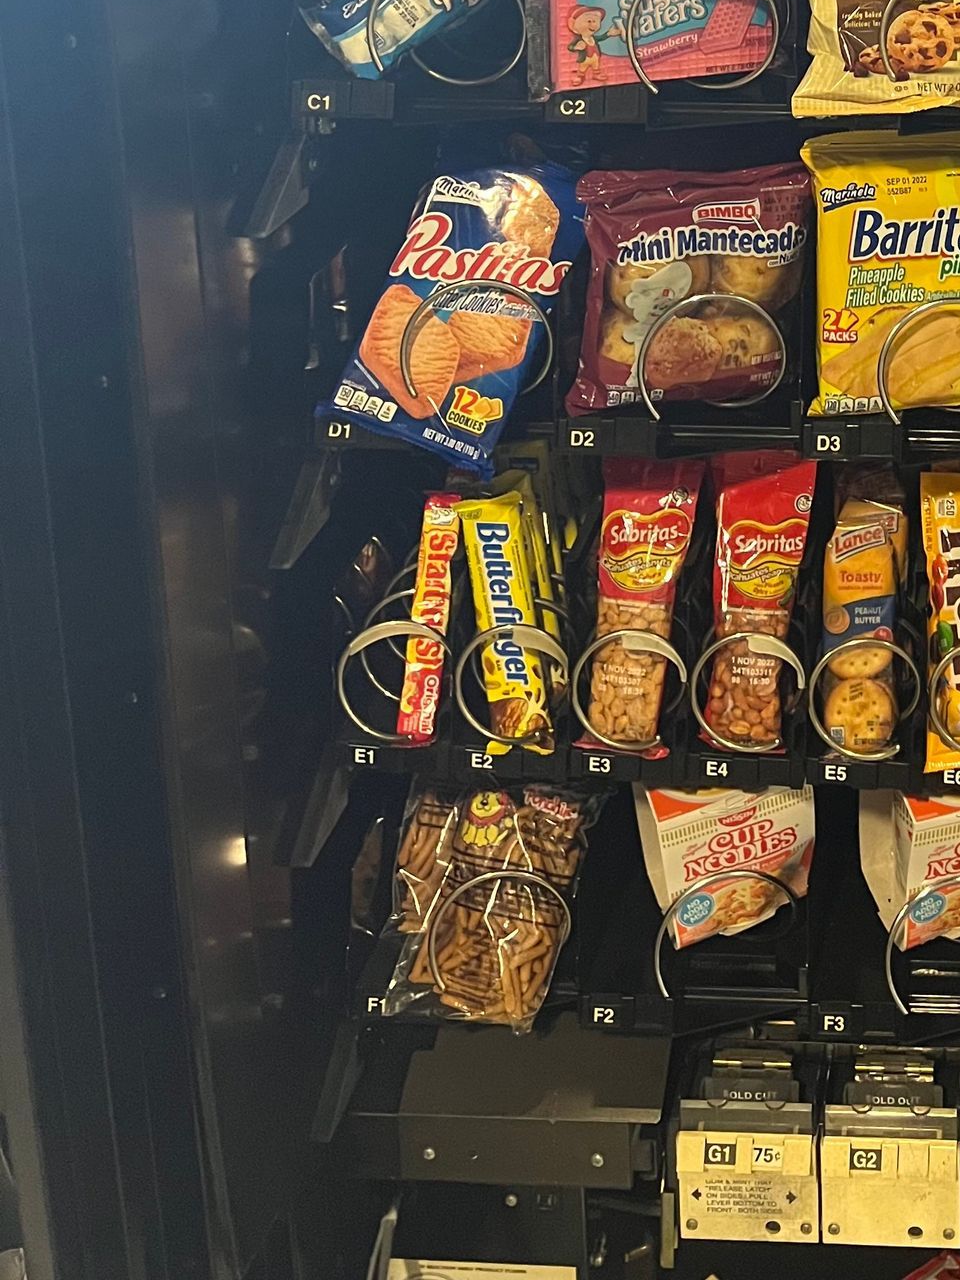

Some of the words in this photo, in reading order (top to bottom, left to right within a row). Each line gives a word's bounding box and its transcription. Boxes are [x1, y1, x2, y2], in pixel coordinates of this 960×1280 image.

[637, 32, 698, 58] Strawberry
[308, 95, 331, 110] C1
[560, 101, 585, 116] C2
[887, 178, 900, 186] SEP
[902, 177, 910, 185] 01
[912, 176, 927, 184] 2022
[820, 182, 876, 205] Marinela
[697, 205, 756, 219] BIMBO
[850, 264, 905, 288] Pineapple
[823, 311, 838, 329] 2
[824, 331, 857, 342] PACKS
[452, 388, 479, 414] 12
[448, 411, 484, 432] COOKIES
[329, 424, 351, 438] D1
[571, 431, 594, 446] D2
[817, 436, 841, 451] D3
[946, 499, 955, 516] 250
[611, 524, 678, 545] Sabritas
[834, 528, 882, 554] Lance
[735, 534, 803, 554] Sabritas
[840, 571, 881, 583] Toasty
[855, 607, 881, 615] PEANUT
[354, 749, 374, 764] E1
[471, 754, 493, 769] E2
[589, 757, 611, 772] E3
[706, 762, 728, 777] E4
[824, 766, 847, 781] E5
[722, 809, 756, 825] NISSIN
[709, 820, 773, 852] CUP
[684, 827, 797, 882] NOODLES
[683, 900, 710, 921] ADDED
[687, 898, 700, 910] NO
[915, 900, 943, 918] ADDED
[921, 898, 934, 908] NO
[690, 909, 709, 924] MSG
[368, 998, 385, 1013] F1
[594, 1009, 614, 1023] F2
[824, 1017, 844, 1031] F3
[708, 1145, 731, 1163] G1
[753, 1147, 781, 1163] 75¢
[853, 1150, 877, 1168] G2
